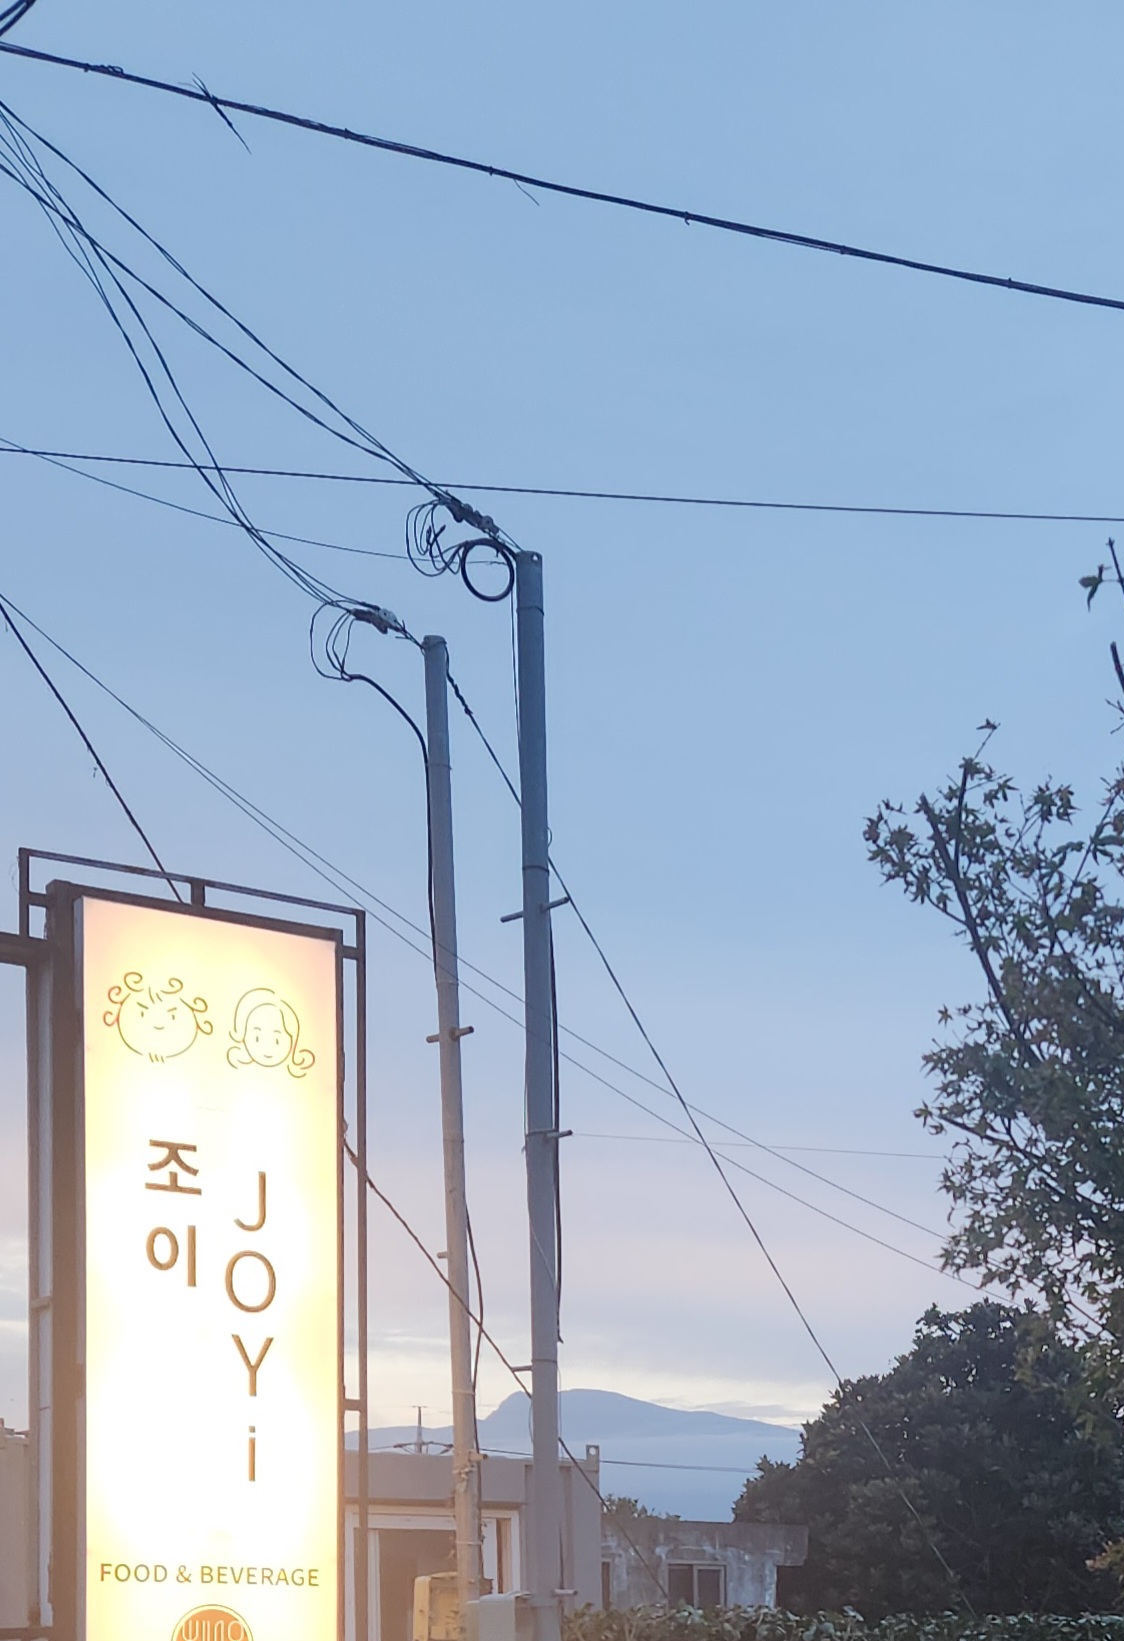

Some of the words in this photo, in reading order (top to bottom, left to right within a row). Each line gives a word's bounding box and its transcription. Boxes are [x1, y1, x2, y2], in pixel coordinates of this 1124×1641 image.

[144, 1138, 202, 1288] 조이
[100, 1563, 168, 1583] FOOD
[176, 1565, 193, 1584] &
[200, 1565, 320, 1587] BEVERAGE
